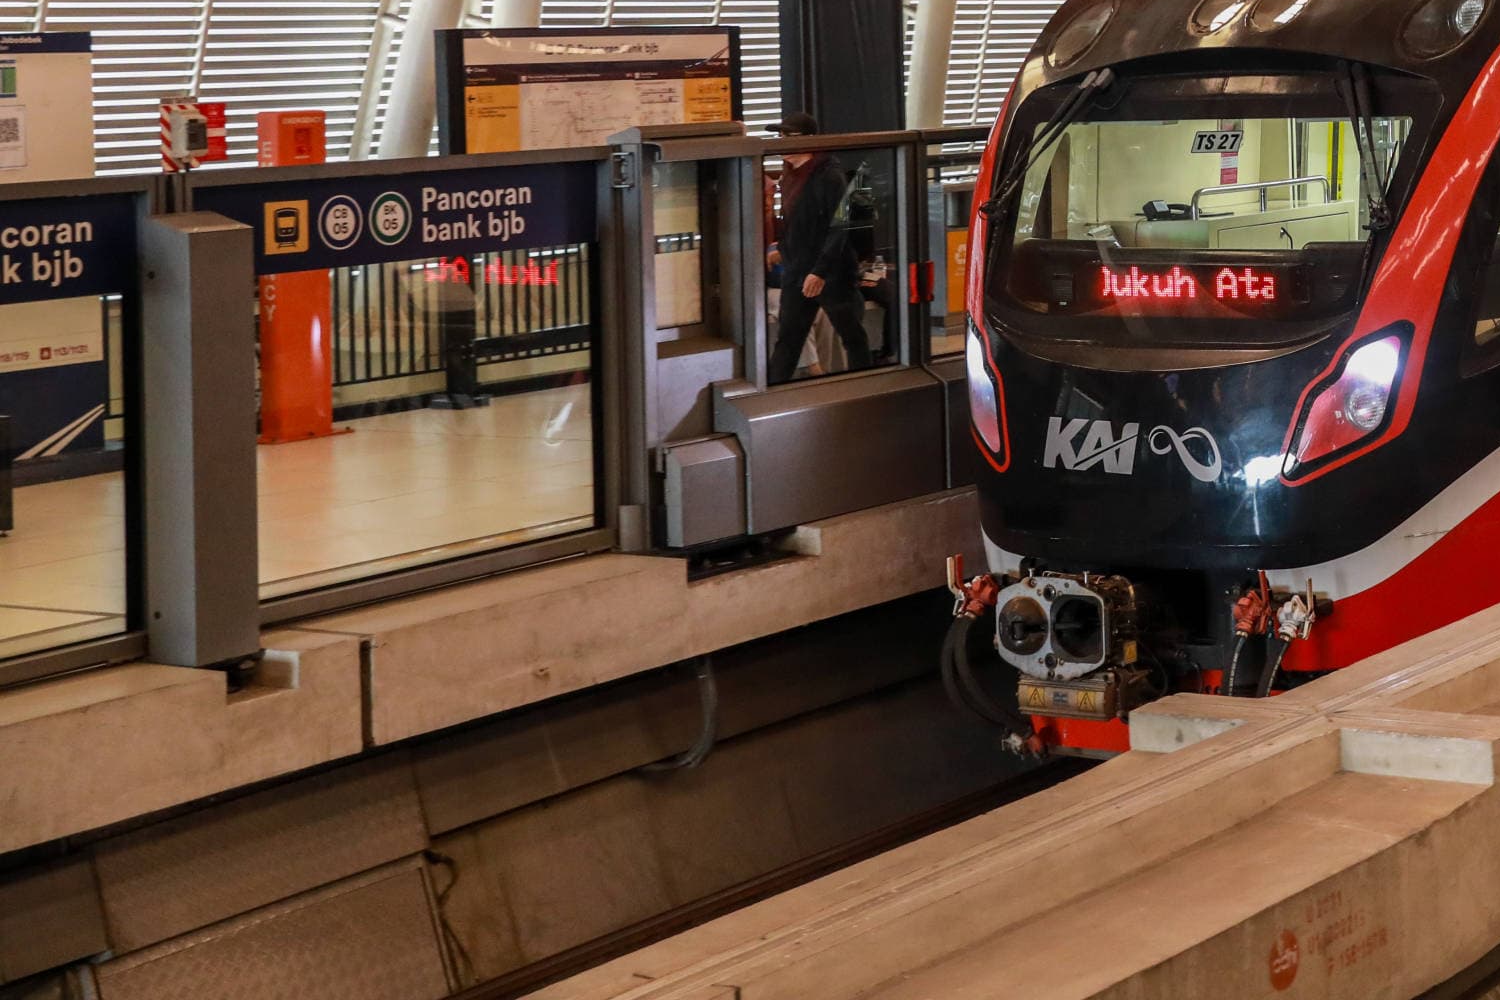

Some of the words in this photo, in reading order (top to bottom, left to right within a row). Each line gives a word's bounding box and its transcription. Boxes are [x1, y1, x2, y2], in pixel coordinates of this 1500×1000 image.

[1197, 134, 1216, 150] TS
[1217, 134, 1240, 150] 27
[333, 207, 348, 219] CB
[384, 204, 397, 216] BK
[422, 186, 532, 213] Pancoran
[0, 221, 93, 249] coran
[333, 222, 349, 236] 05
[383, 218, 398, 231] 05
[422, 213, 482, 243] bank
[489, 210, 525, 242] bjb
[32, 249, 84, 287] bjb
[1216, 268, 1275, 299] Ata
[1043, 416, 1139, 475] KAI
